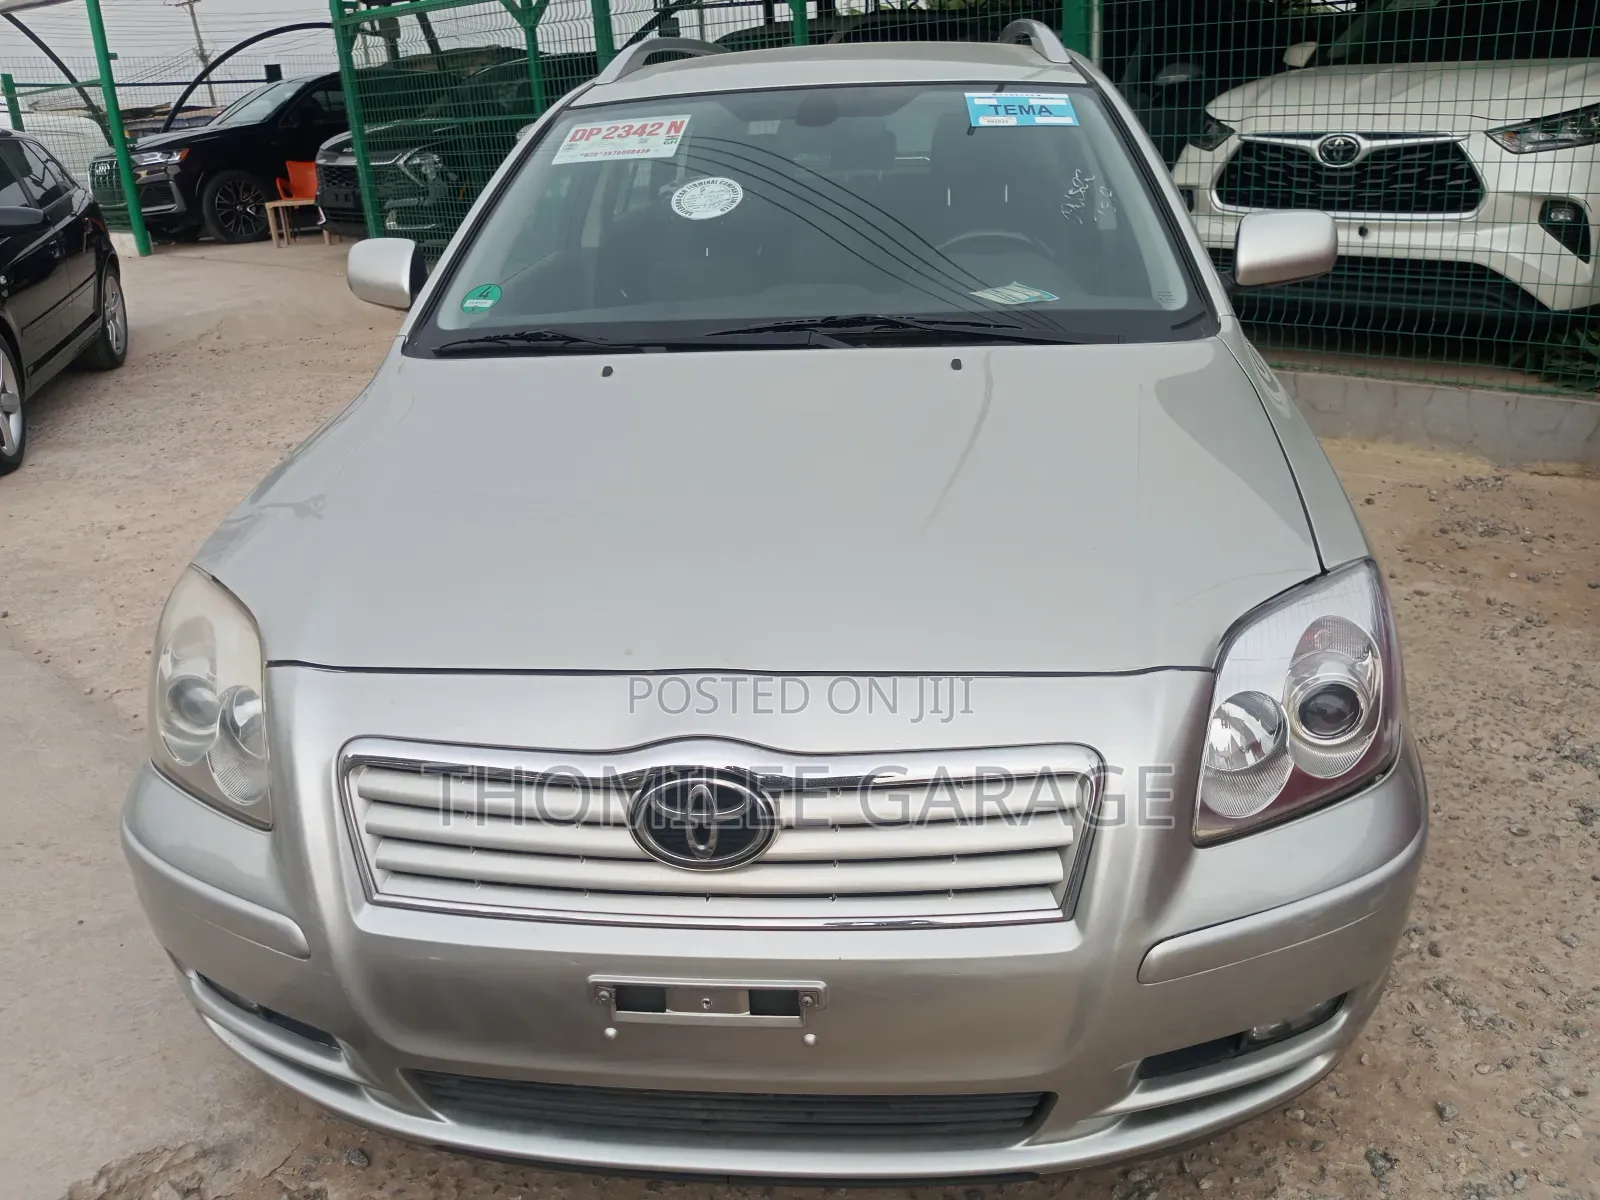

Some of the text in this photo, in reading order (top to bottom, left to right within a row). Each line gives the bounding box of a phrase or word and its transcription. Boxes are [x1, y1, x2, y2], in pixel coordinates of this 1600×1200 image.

[989, 104, 1054, 116] TEMA
[568, 120, 685, 142] DP 2342 N
[478, 285, 492, 299] 4
